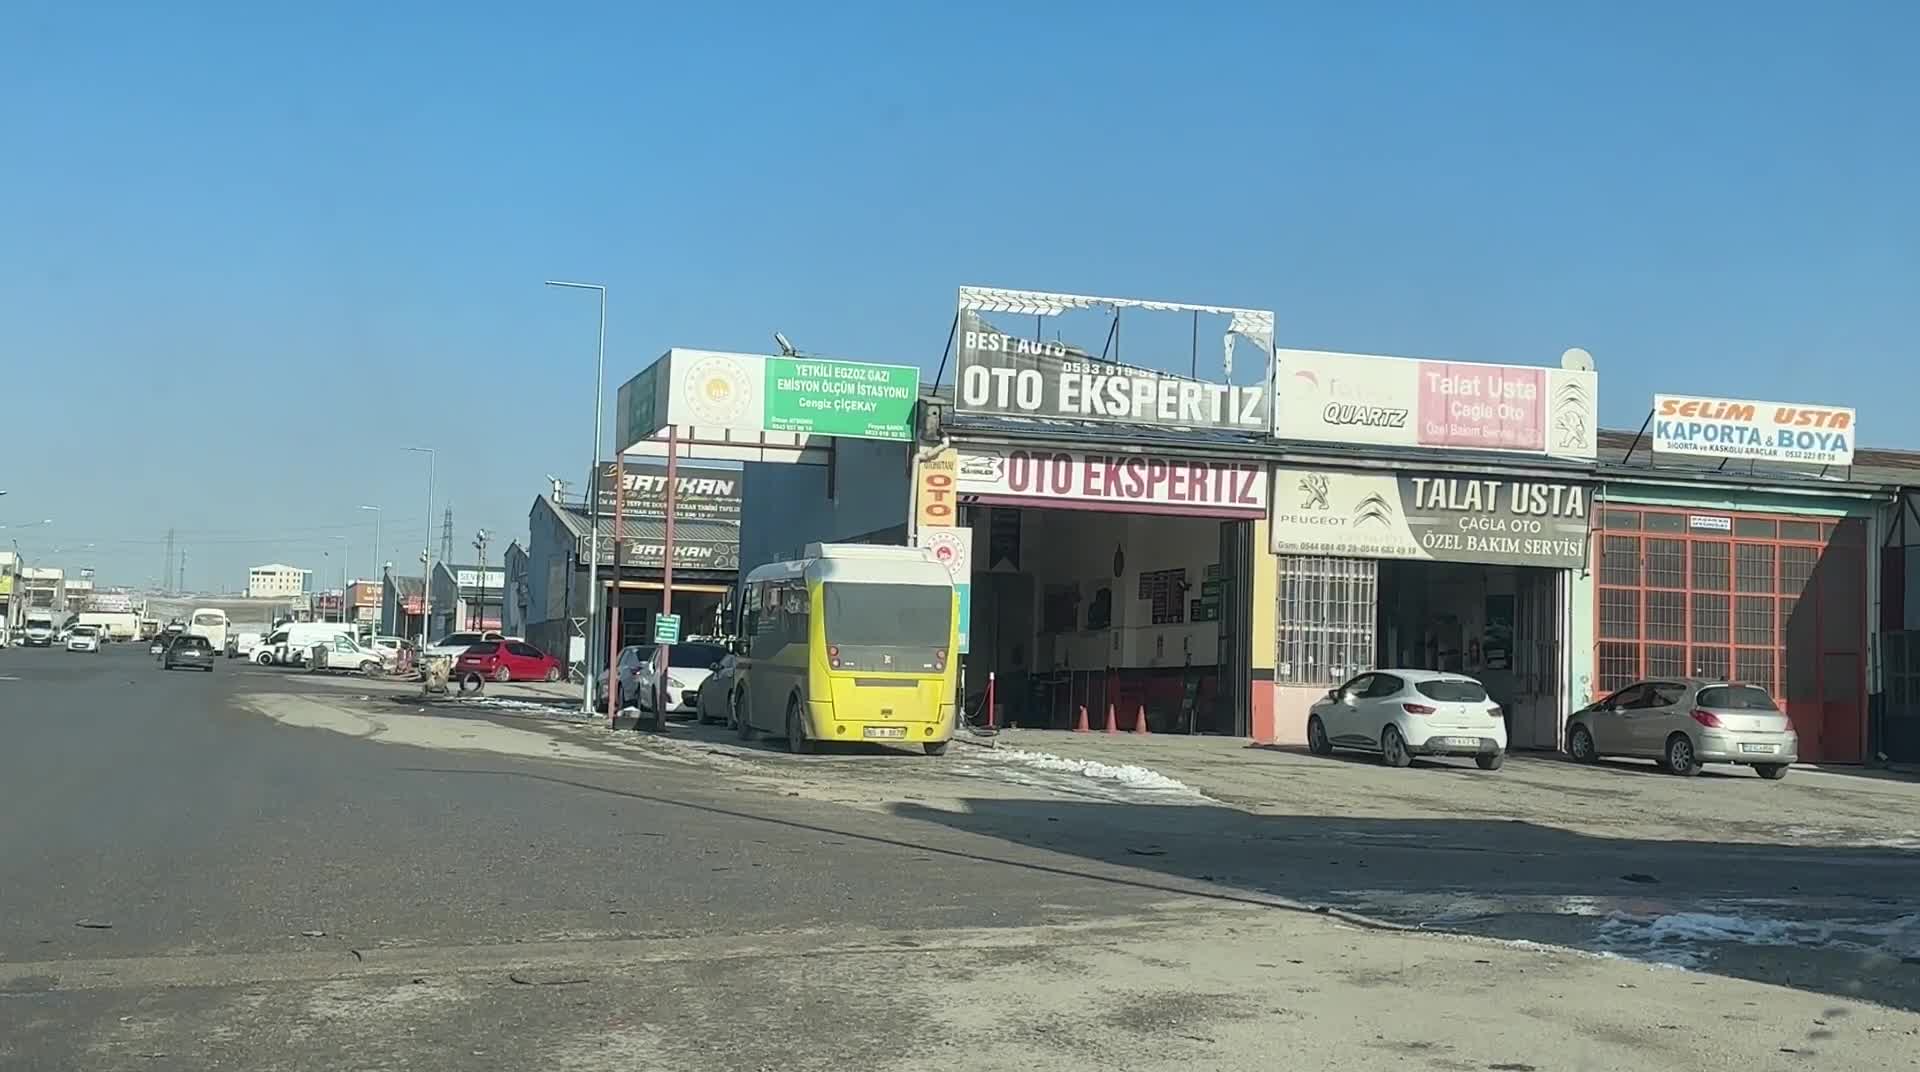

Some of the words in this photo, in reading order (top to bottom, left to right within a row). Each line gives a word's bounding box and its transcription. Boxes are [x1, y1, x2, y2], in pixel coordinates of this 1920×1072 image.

[966, 332, 1010, 352] BEST
[796, 363, 832, 378] YETKİLİ
[834, 368, 866, 381] EGZOZ
[867, 370, 890, 383] GAZI
[777, 377, 820, 393] EMİSYON
[821, 379, 856, 397] ÖLÇÜM
[857, 382, 909, 399] İSTASYONU
[964, 365, 1043, 411] OTO
[1426, 371, 1480, 396] Talat
[1488, 375, 1536, 400] Usta
[799, 397, 832, 410] Cengiz
[834, 399, 877, 413] ÇİÇEKAY
[1323, 402, 1408, 428] QUARTZ
[1498, 402, 1524, 420] Oto
[1774, 408, 1850, 429] USTA
[1656, 421, 1762, 446] KAPORTA
[1765, 436, 1774, 447] &
[1778, 429, 1848, 452] BOYA
[1009, 451, 1073, 495] OTO
[1412, 478, 1502, 512] TALAT
[1511, 482, 1584, 518] USTA
[1280, 515, 1347, 525] PEUGEOT
[1459, 515, 1507, 532] ÇAĞLA
[1511, 519, 1541, 533] OTO
[1423, 530, 1463, 549] ÖZEL
[1467, 535, 1520, 553] BAKIM
[1524, 538, 1583, 557] SERVİSİ
